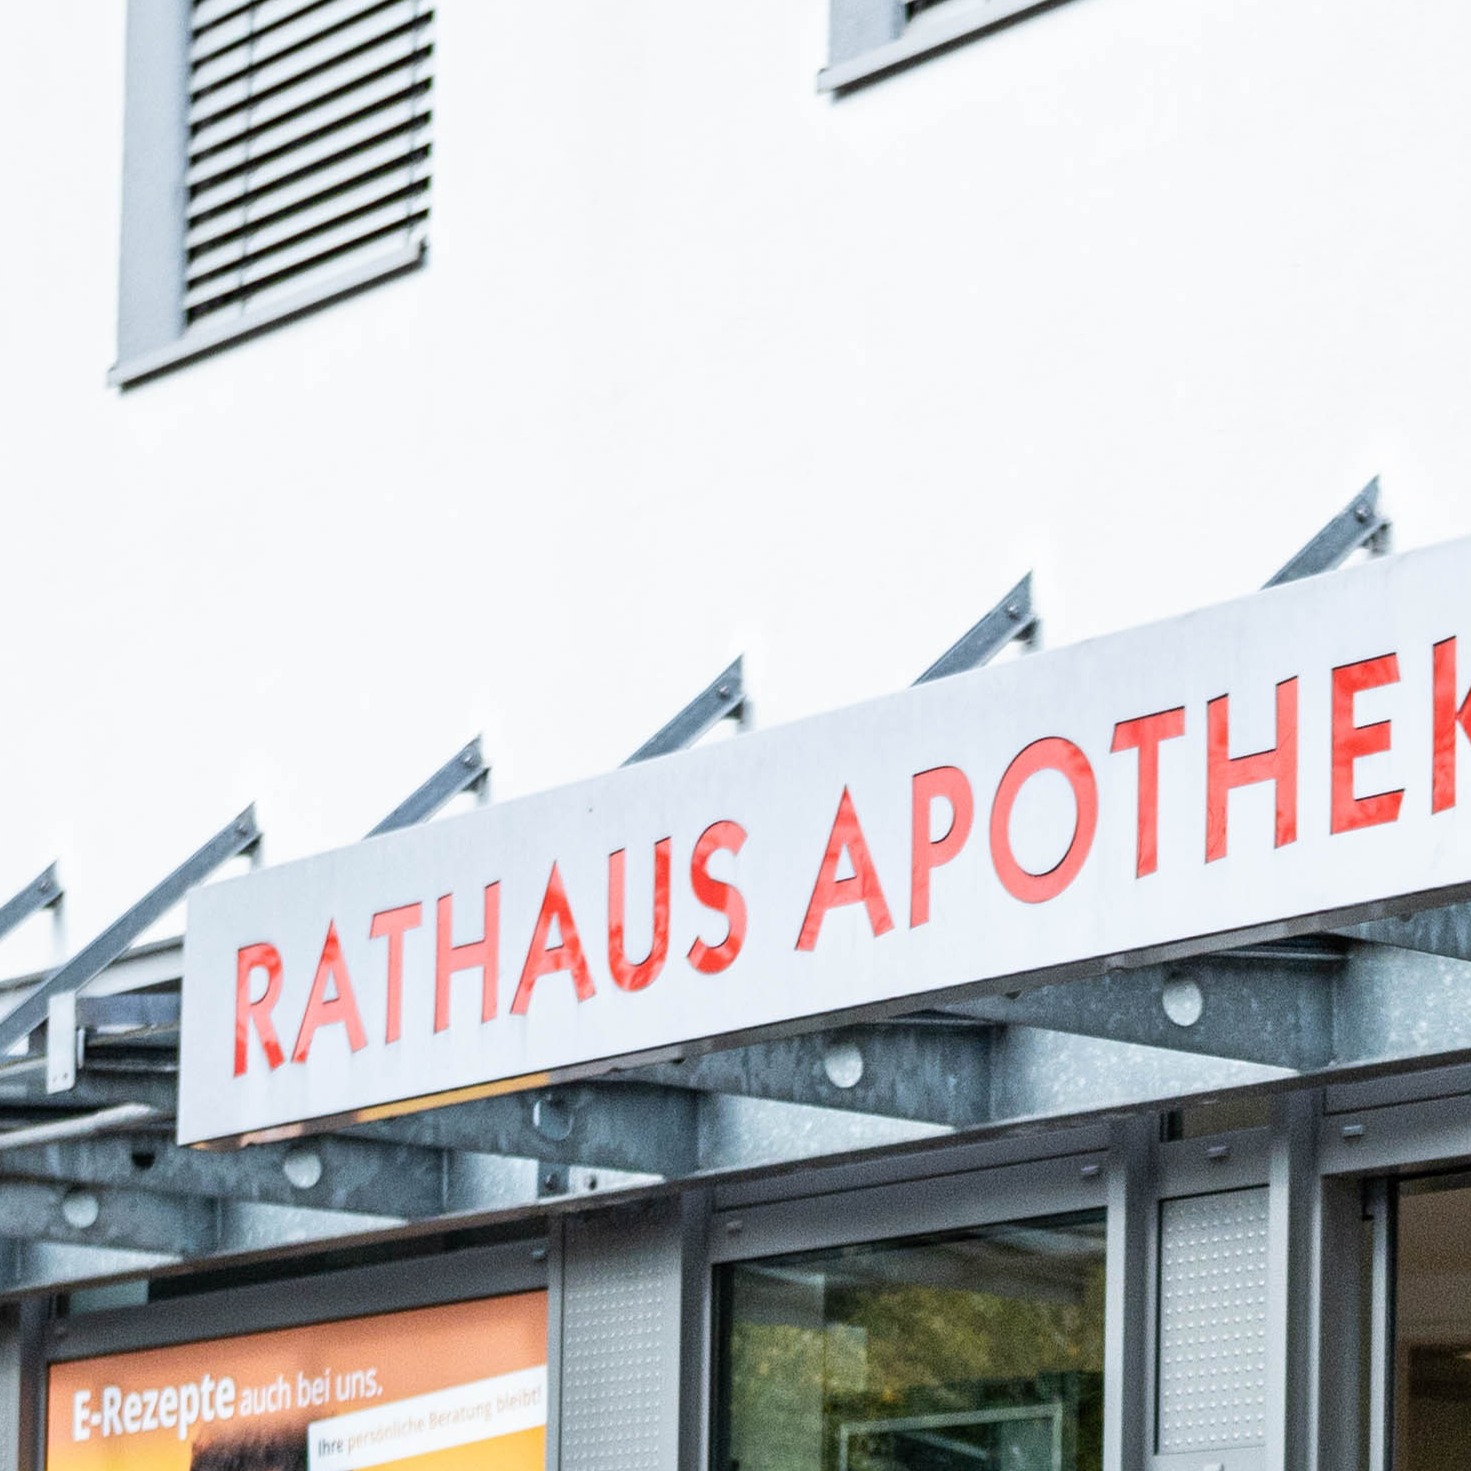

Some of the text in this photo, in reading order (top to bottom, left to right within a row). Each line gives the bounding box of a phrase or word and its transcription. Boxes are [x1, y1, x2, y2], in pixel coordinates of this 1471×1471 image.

[233, 820, 749, 1078] RATHAUS
[72, 1366, 384, 1442] E-Rezepte auch bei uns.
[317, 1384, 543, 1458] Ihre persönliche Beratung bleibt!
